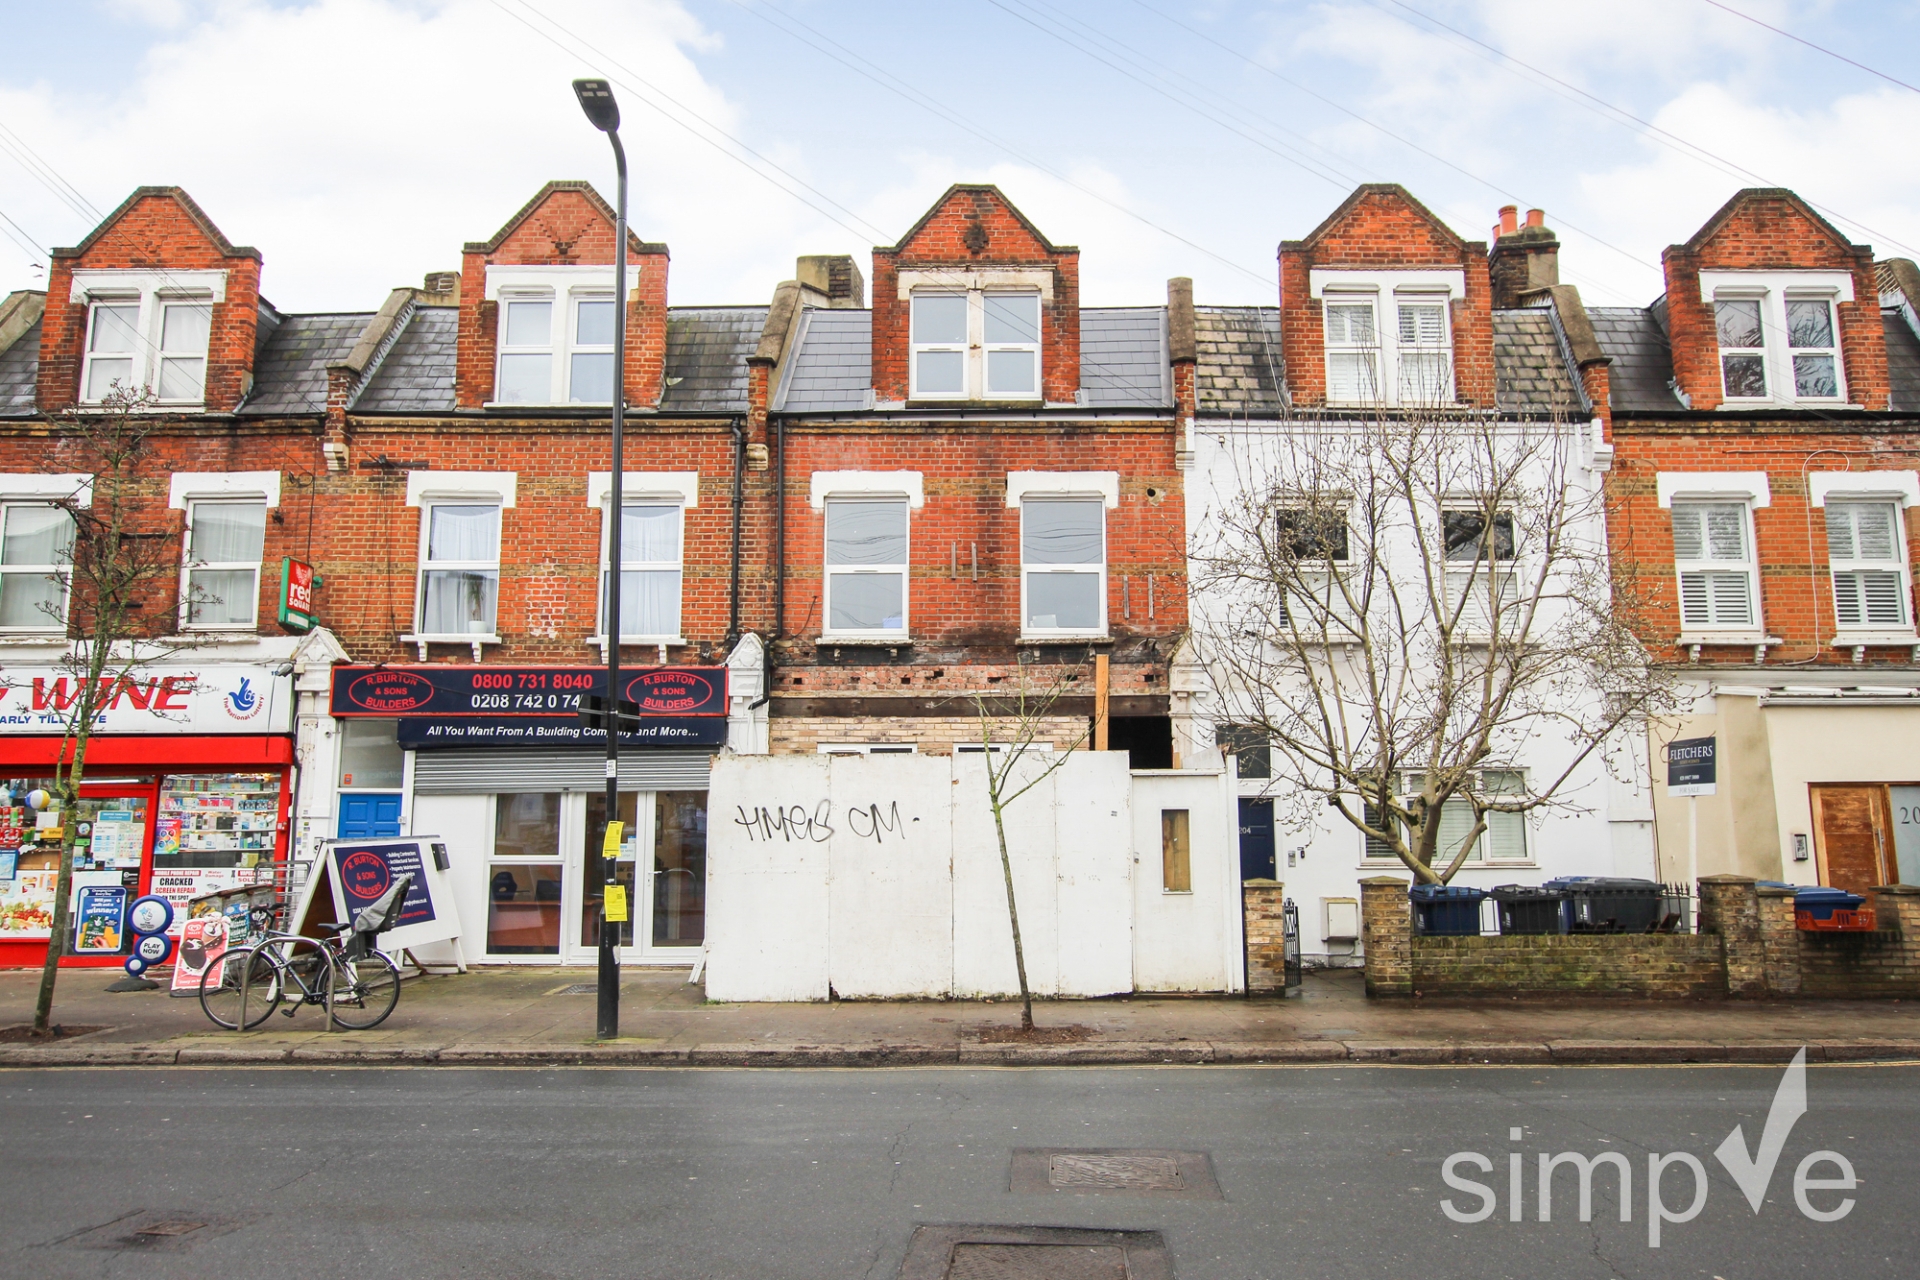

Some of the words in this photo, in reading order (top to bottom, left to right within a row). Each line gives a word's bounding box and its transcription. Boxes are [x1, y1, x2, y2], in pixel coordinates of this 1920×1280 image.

[290, 582, 311, 603] red
[472, 674, 513, 688] 0800
[518, 674, 546, 688] 731
[552, 674, 593, 688] 8040
[33, 677, 197, 710] WINE
[375, 687, 382, 695] &
[384, 687, 408, 695] SONS
[366, 696, 416, 709] BUILDERS
[471, 694, 510, 708] 0208
[514, 694, 543, 708] 742
[562, 694, 580, 708] 74
[643, 697, 695, 709] BUILDERS
[426, 726, 442, 736] All
[445, 726, 464, 736] You
[467, 726, 494, 736] Want
[496, 726, 523, 736] From
[525, 727, 534, 736] A
[536, 727, 580, 738] Building
[1670, 745, 1713, 760] FLETCHERS
[160, 878, 193, 886] CRACKED
[362, 872, 376, 880] SONS
[356, 882, 382, 895] BUILDERS
[86, 906, 119, 915] winner?
